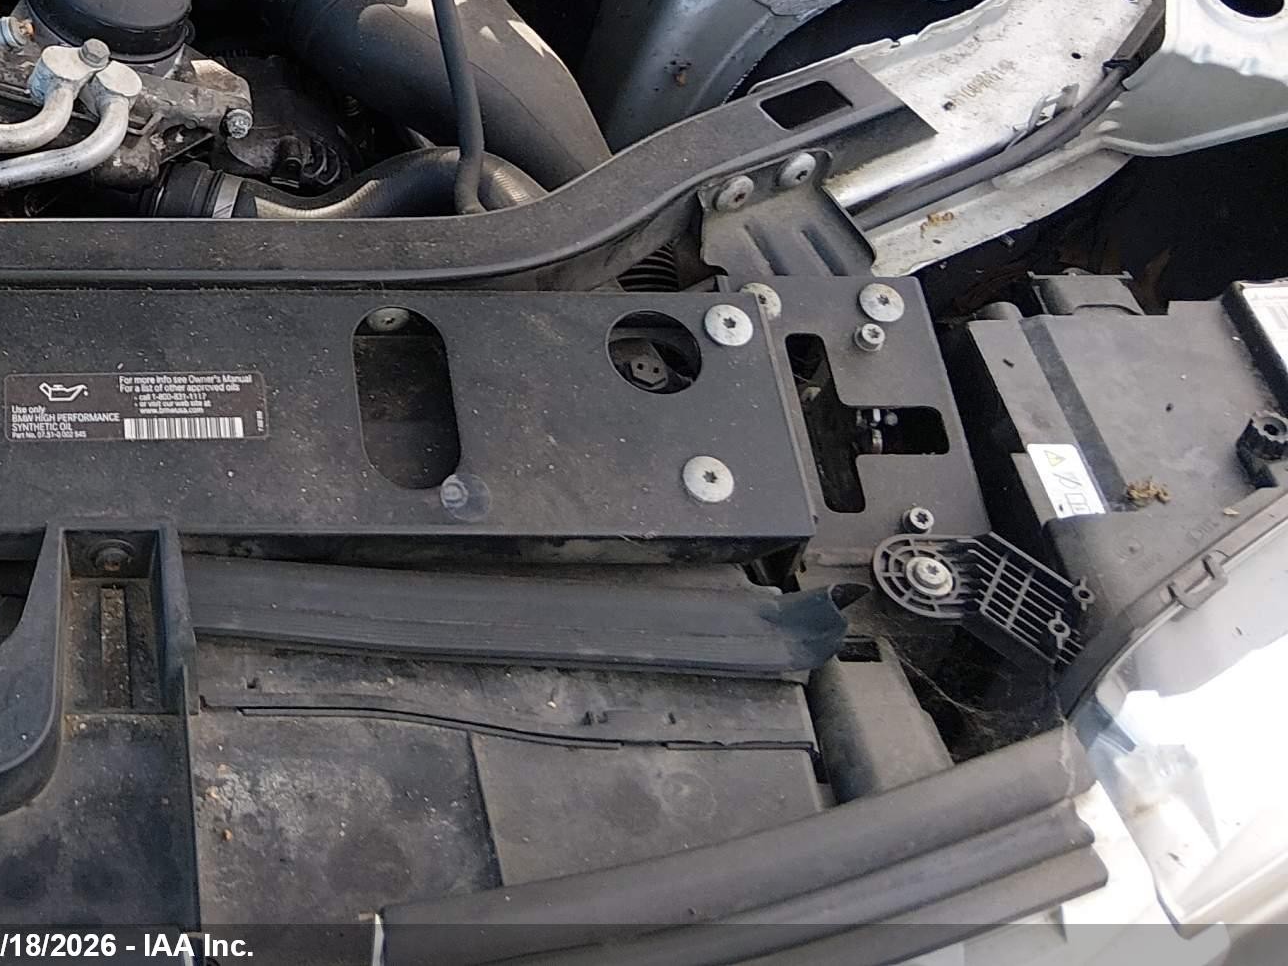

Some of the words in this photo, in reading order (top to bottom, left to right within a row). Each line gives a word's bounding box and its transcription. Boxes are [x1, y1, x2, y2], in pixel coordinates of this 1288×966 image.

[119, 376, 132, 384] For
[134, 376, 155, 384] more
[188, 375, 221, 383] Owner's
[222, 375, 252, 383] Manual
[141, 384, 153, 392] list
[154, 384, 163, 392] of
[186, 384, 224, 392] approved
[226, 383, 240, 391] oils
[28, 406, 45, 414] only
[35, 414, 55, 422] HIGH
[57, 413, 120, 422] PERFORMANCE
[12, 423, 58, 431] SYNTHETIC
[59, 423, 72, 431] OIL
